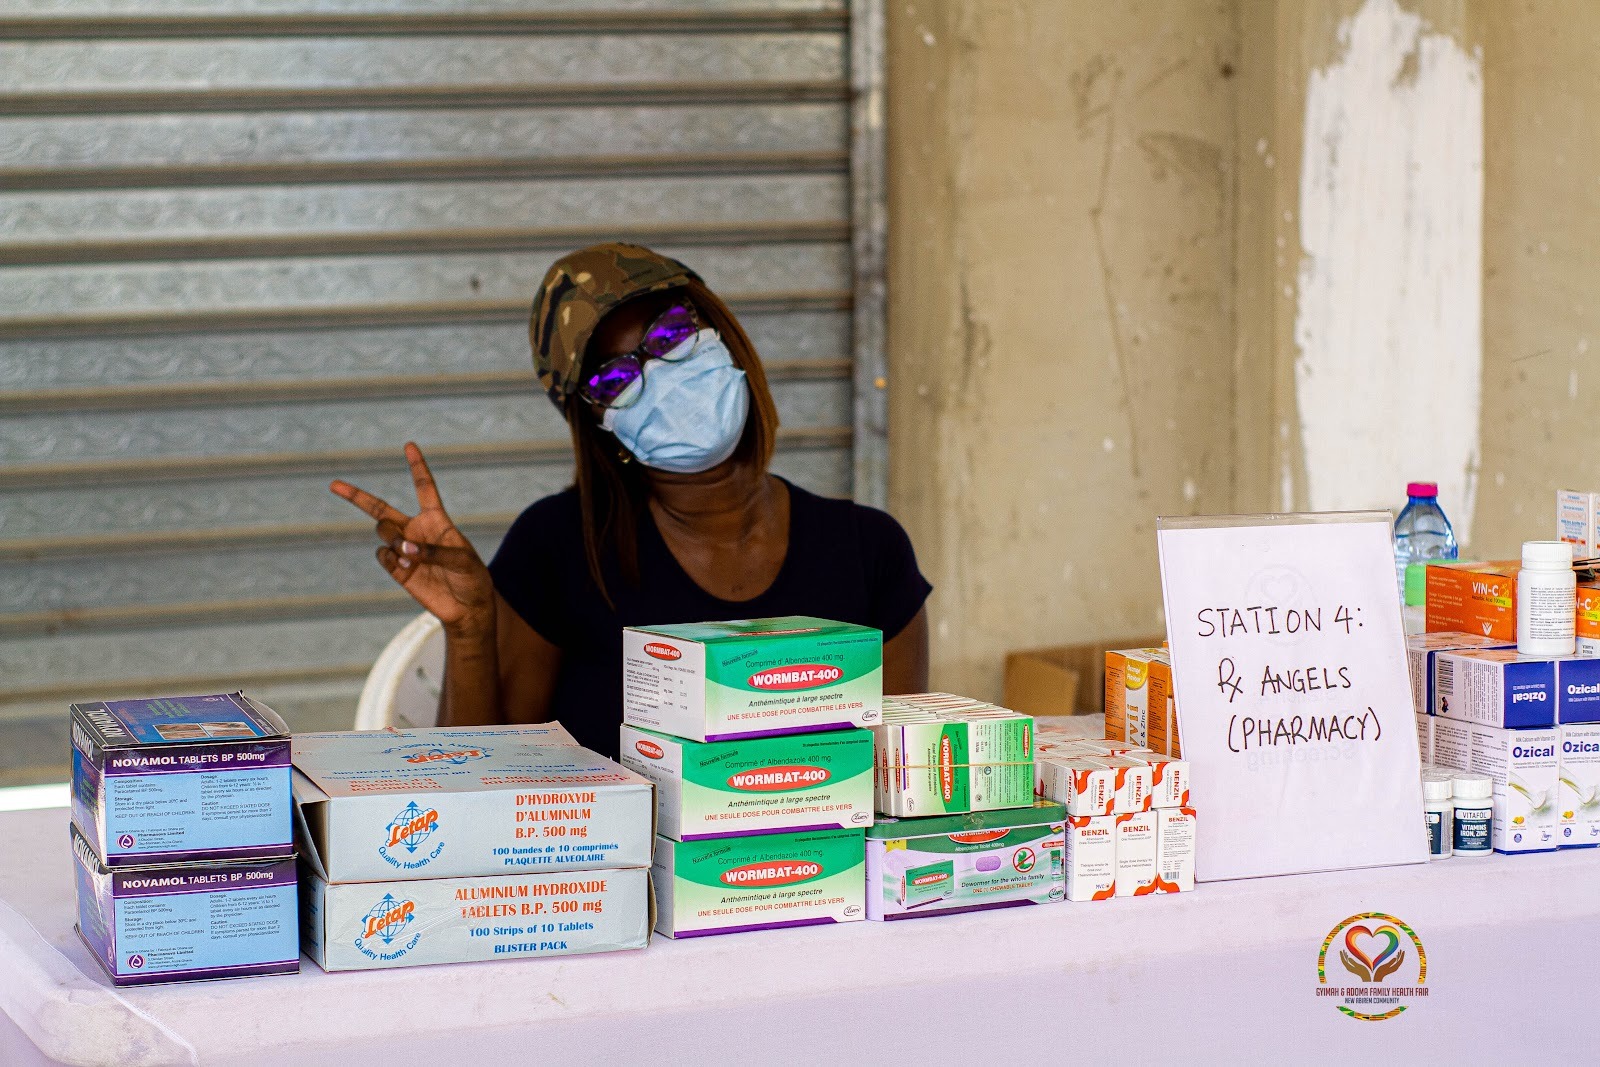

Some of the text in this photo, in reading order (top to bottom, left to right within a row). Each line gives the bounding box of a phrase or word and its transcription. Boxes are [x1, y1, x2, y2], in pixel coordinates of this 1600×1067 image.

[1472, 581, 1499, 596] VIN-C
[1198, 605, 1364, 638] STATION 4:
[784, 654, 820, 665] Albendazole
[822, 653, 833, 661] 400
[753, 668, 839, 686] WORMBAT-400
[1261, 666, 1352, 696] ANGELS
[749, 692, 843, 708] Anthémintique à large spectre
[1512, 691, 1546, 703] Ozical
[762, 710, 778, 718] DOSE
[780, 708, 796, 716] POUR
[798, 705, 834, 714] COMBATTRE
[1228, 706, 1381, 752] (PHARMACY)
[1513, 745, 1554, 758] Ozical
[1562, 741, 1600, 753] Ozica
[113, 752, 265, 768] NOVAMOL TABLETS BP 500mg
[767, 756, 806, 766] Albendazole
[808, 755, 820, 763] 400
[942, 738, 951, 800] WORMBAT-400
[733, 769, 826, 787] WORMBAT-400
[516, 792, 597, 806] D'HYDROXYDE
[728, 797, 779, 808] Anthémintique
[786, 795, 803, 805] large
[804, 794, 831, 804] spectre
[516, 808, 591, 822] D'ALUMINIUM
[720, 812, 740, 820] SEULE
[762, 809, 780, 817] POUR
[782, 807, 820, 816] COMBATTRE
[836, 803, 853, 811] VERS
[1462, 811, 1487, 819] VITAFOL
[386, 808, 439, 848] Letap
[515, 826, 588, 839] B.P. 500 mg
[1081, 829, 1109, 837] BENZIL
[1123, 825, 1150, 833] BENZIL
[378, 841, 445, 869] Quality Health Care
[492, 842, 619, 856] 100 bandes de 10 comprimés
[760, 852, 798, 861] Albendazole
[504, 854, 606, 866] PLAQUETTE ALVEOLAIRE
[122, 871, 274, 889] NOVAMOL TABLETS BP 500mg
[726, 864, 818, 883] WORMBAT-400
[915, 874, 948, 885] WORMBAT-400
[961, 880, 990, 888] Dewormer
[1027, 873, 1045, 882] family
[455, 880, 608, 901] ALUMINIUM HYDROXIDE
[721, 892, 771, 904] Anthémintique
[778, 890, 796, 900] large
[797, 888, 823, 897] spectre
[461, 899, 602, 919] TABLETS B.P. 500 mg
[713, 908, 734, 916] SEULE
[735, 906, 753, 914] DOSE
[754, 904, 773, 912] POUR
[774, 901, 812, 910] COMBATTRE
[363, 900, 415, 940] Letap
[469, 921, 594, 937] 100 Strips of 10 Tablets
[354, 932, 421, 961] Quality Health Care
[494, 940, 568, 954] BLISTER PACK
